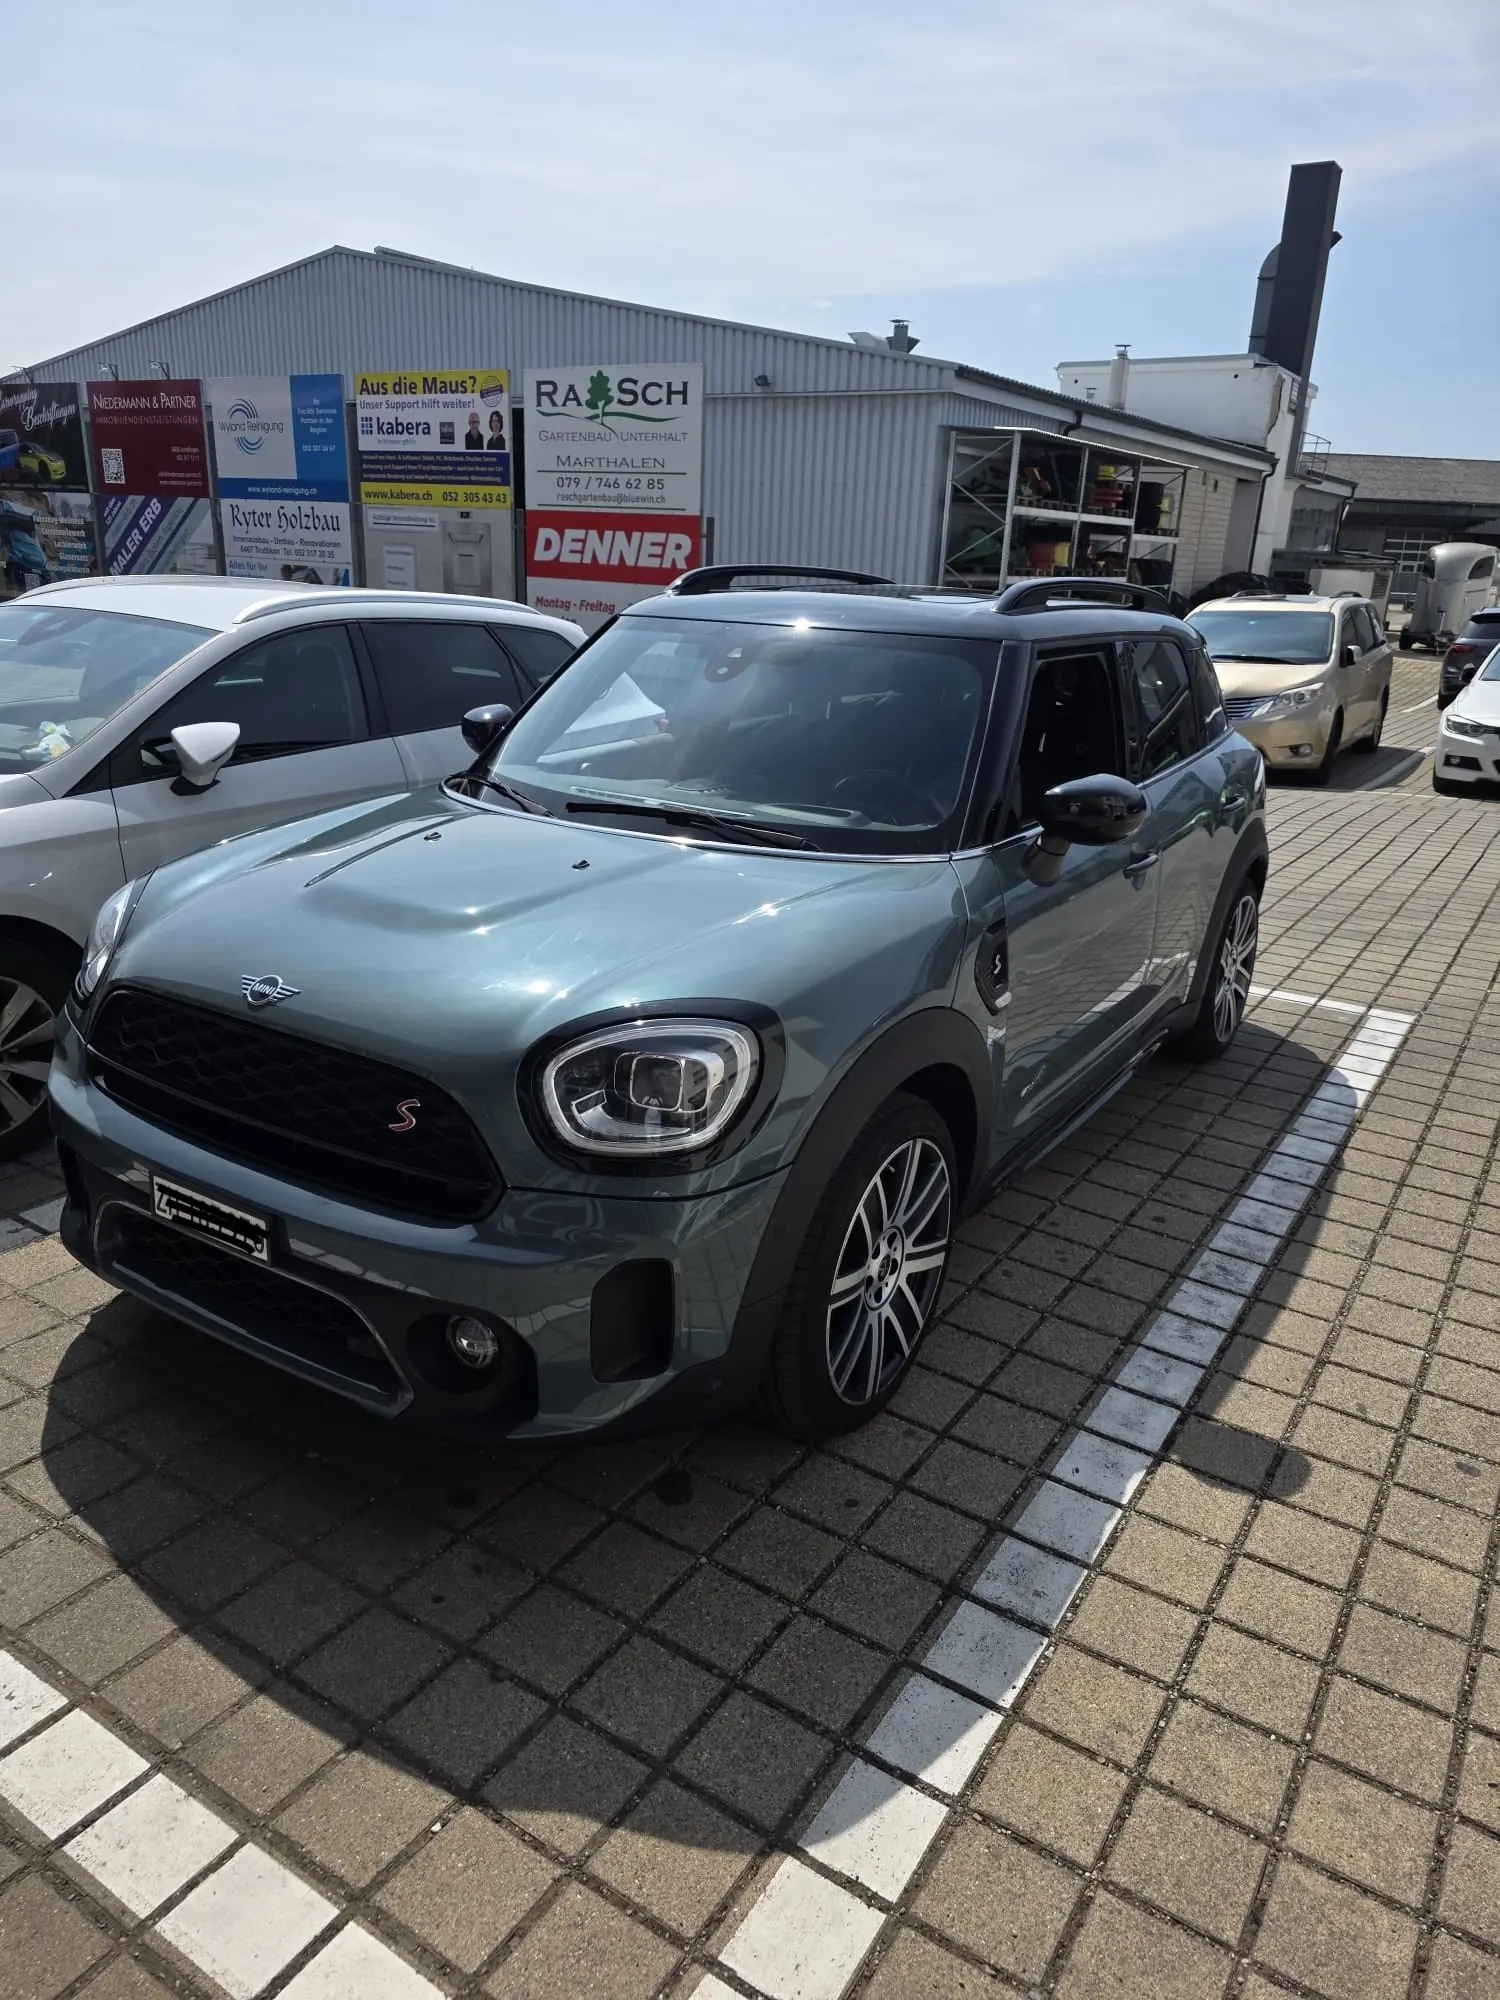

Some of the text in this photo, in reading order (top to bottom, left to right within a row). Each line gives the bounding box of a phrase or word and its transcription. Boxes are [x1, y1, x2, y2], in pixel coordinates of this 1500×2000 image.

[360, 377, 388, 395] Aus
[392, 376, 418, 395] die
[422, 376, 477, 395] Maus?
[152, 396, 159, 409] &
[360, 399, 475, 412] Unser Support hilft weiter!
[21, 401, 76, 431] Beschriftungen
[219, 420, 284, 434] Wyland Reinigung
[376, 417, 431, 436] kabera
[538, 430, 689, 443] GARTENBAU UNTERHALT
[556, 454, 665, 469] MARTHALEN
[556, 476, 665, 490] 079 / 746 62 85
[247, 486, 318, 496] www.wyland-reinigung.ch
[364, 489, 508, 504] www.kabera.ch 052 305 43 43
[556, 492, 666, 505] raschgartenbau@bluewin.ch
[230, 504, 272, 534] Ryter
[277, 505, 341, 534] Holzbau
[109, 528, 143, 576] MALER
[139, 498, 162, 533] ERB
[274, 536, 295, 546] Umbau
[299, 538, 341, 549] Renovationen
[533, 527, 692, 570] DENNER
[229, 560, 245, 570] Alles
[535, 595, 571, 611] Montag
[578, 599, 616, 615] Freitag
[252, 982, 276, 996] MINI
[388, 1098, 421, 1132] S
